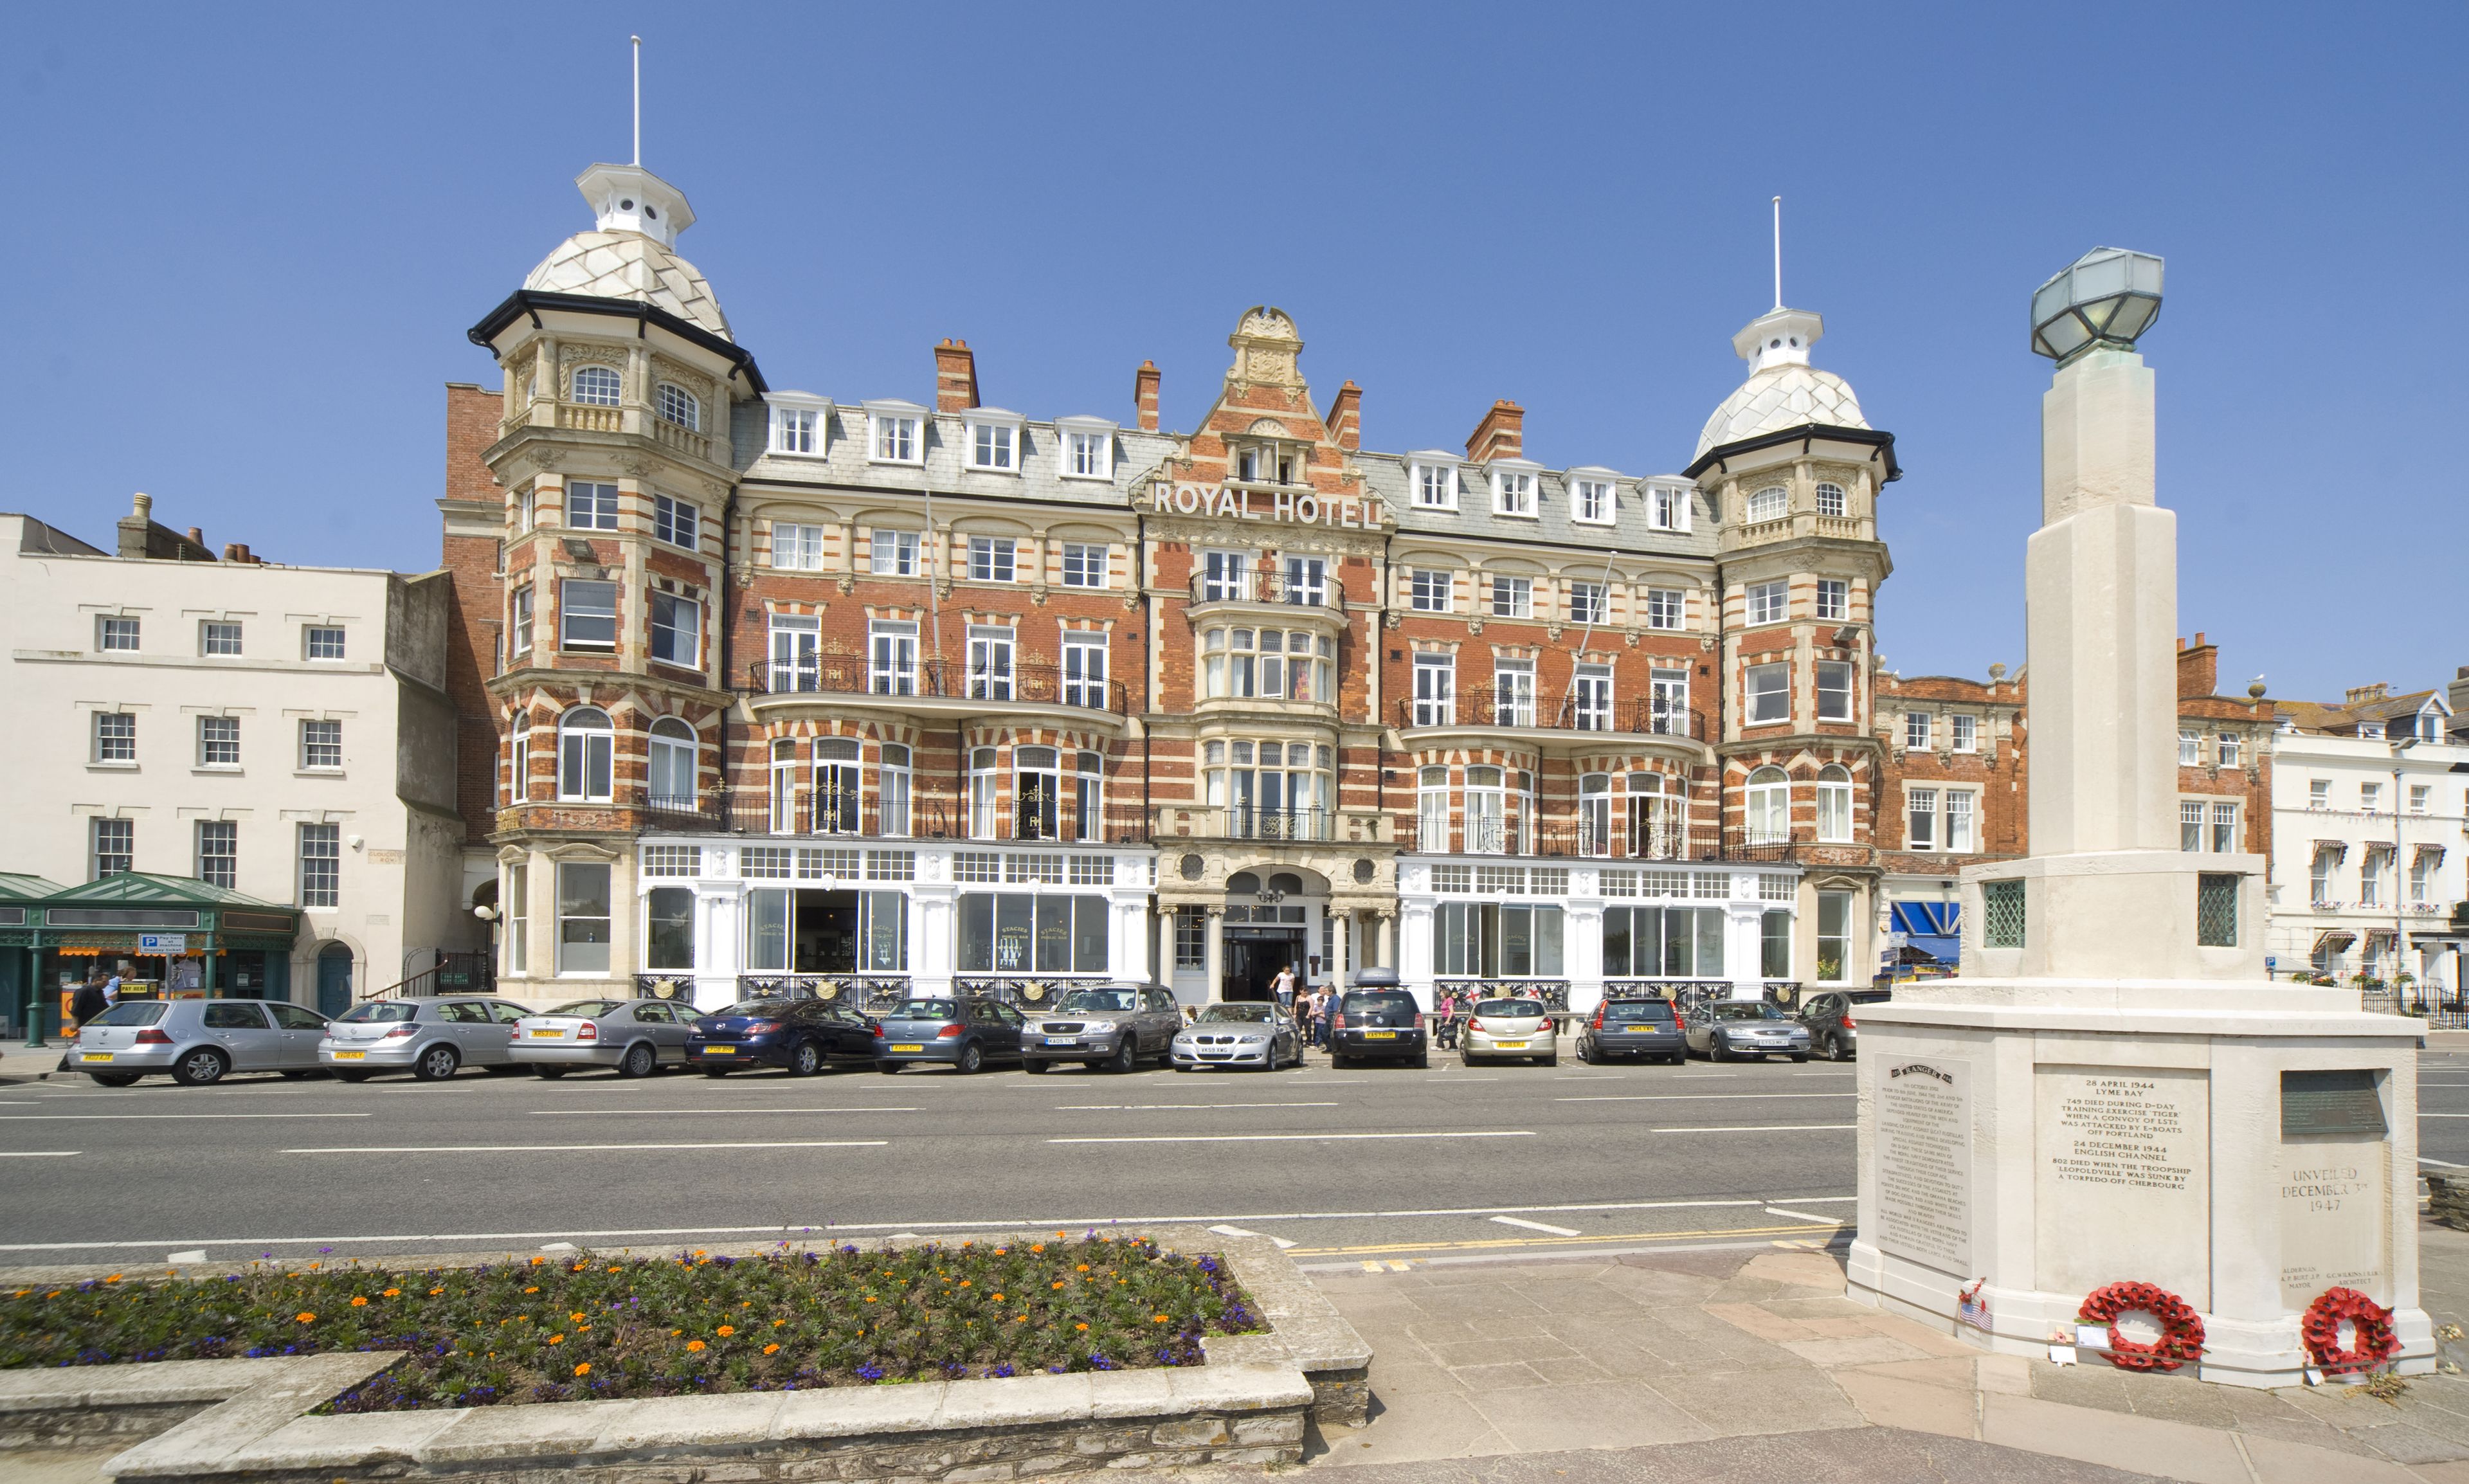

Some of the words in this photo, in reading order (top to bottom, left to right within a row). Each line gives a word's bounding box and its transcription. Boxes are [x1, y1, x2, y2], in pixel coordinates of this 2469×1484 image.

[1155, 483, 1261, 520] ROYAL
[1274, 492, 1382, 530] HOTEL
[1040, 927, 1067, 936] STACIES
[1905, 1065, 1938, 1078] RANGER
[2090, 1142, 2139, 1151] DECEMBER
[2119, 1152, 2167, 1161] CHANNEL
[2141, 1165, 2191, 1174] TROOPSHIP
[2293, 1168, 2356, 1181] UNVEILED
[2129, 1180, 2184, 1190] CHERBOURG
[2283, 1185, 2349, 1198] DECEMBER
[2311, 1200, 2340, 1211] 1947
